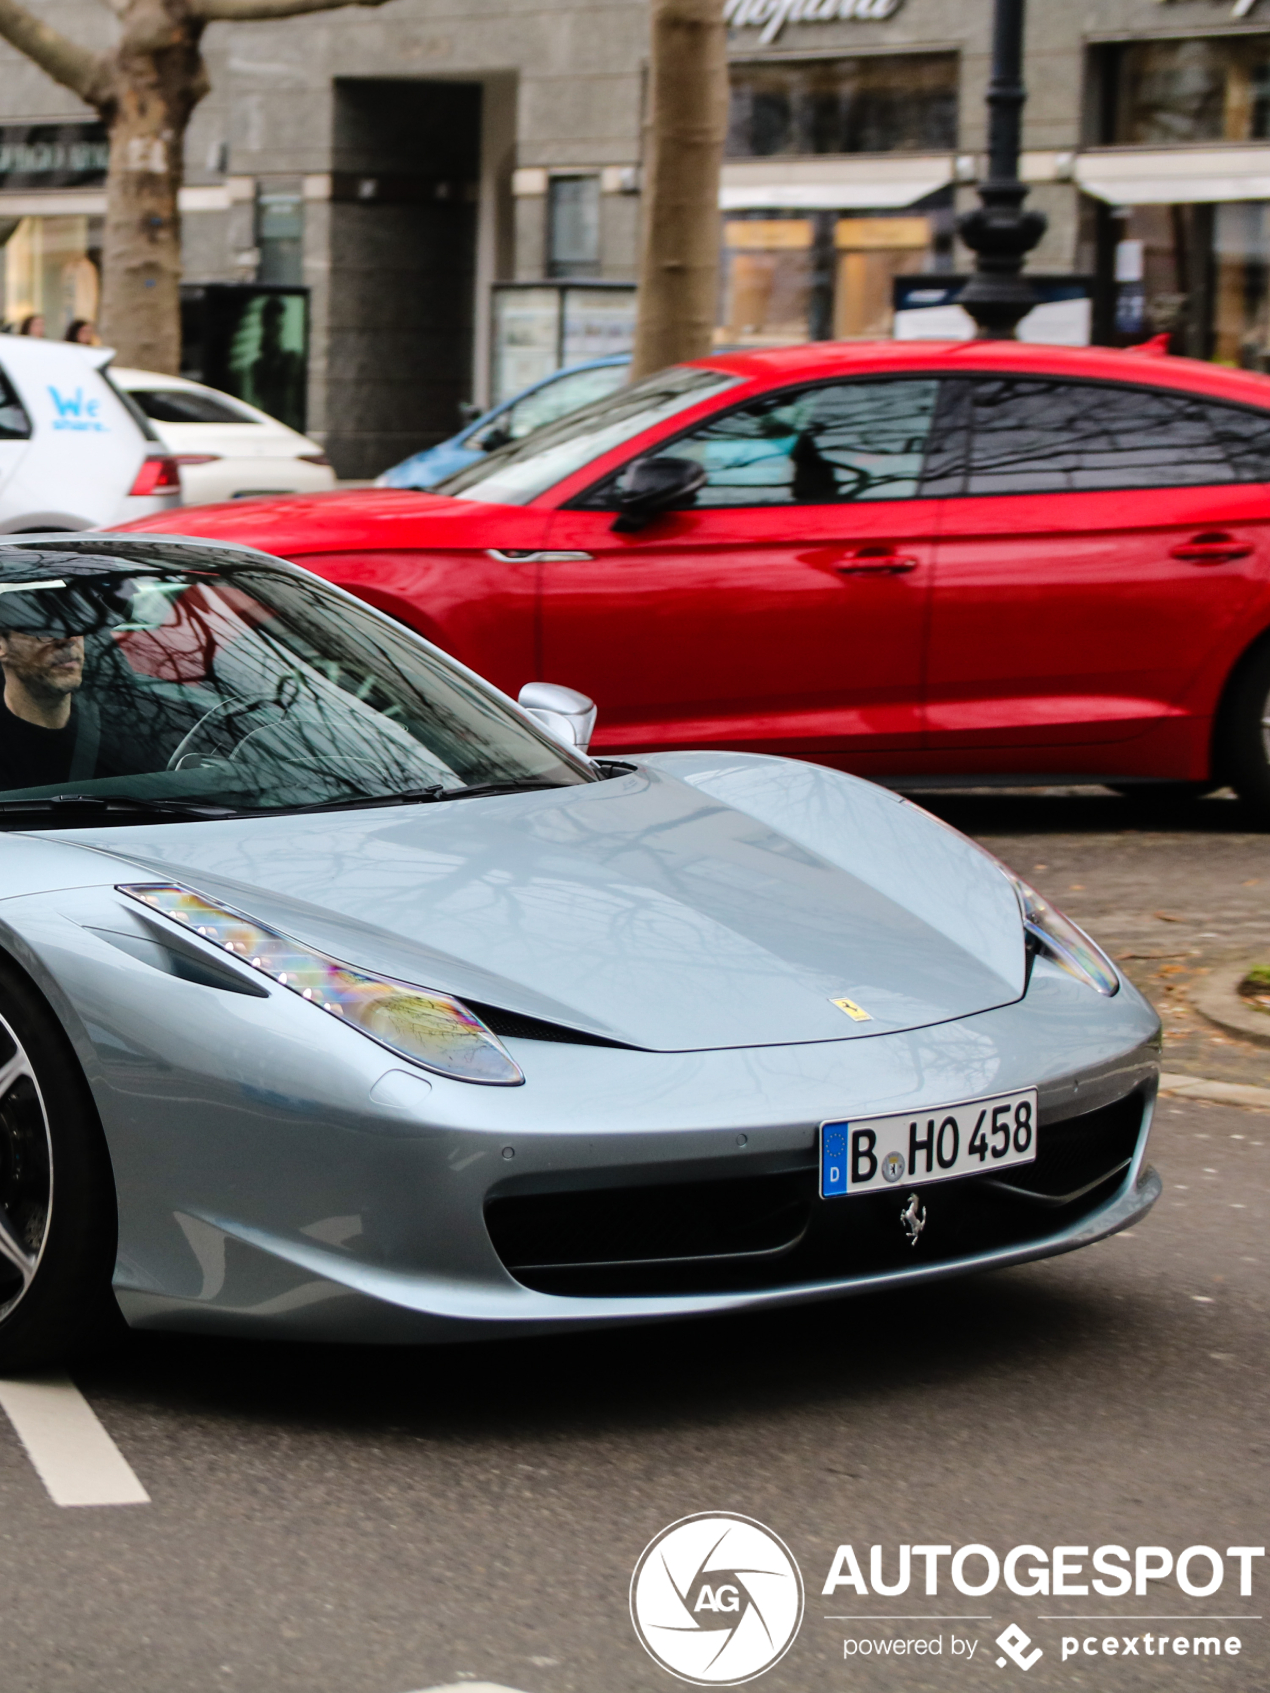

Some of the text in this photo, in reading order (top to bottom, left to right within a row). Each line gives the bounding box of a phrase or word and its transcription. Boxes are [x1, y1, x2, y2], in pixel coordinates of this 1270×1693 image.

[47, 385, 100, 417] We
[851, 1100, 1033, 1184] B HO 458
[829, 1166, 840, 1183] D
